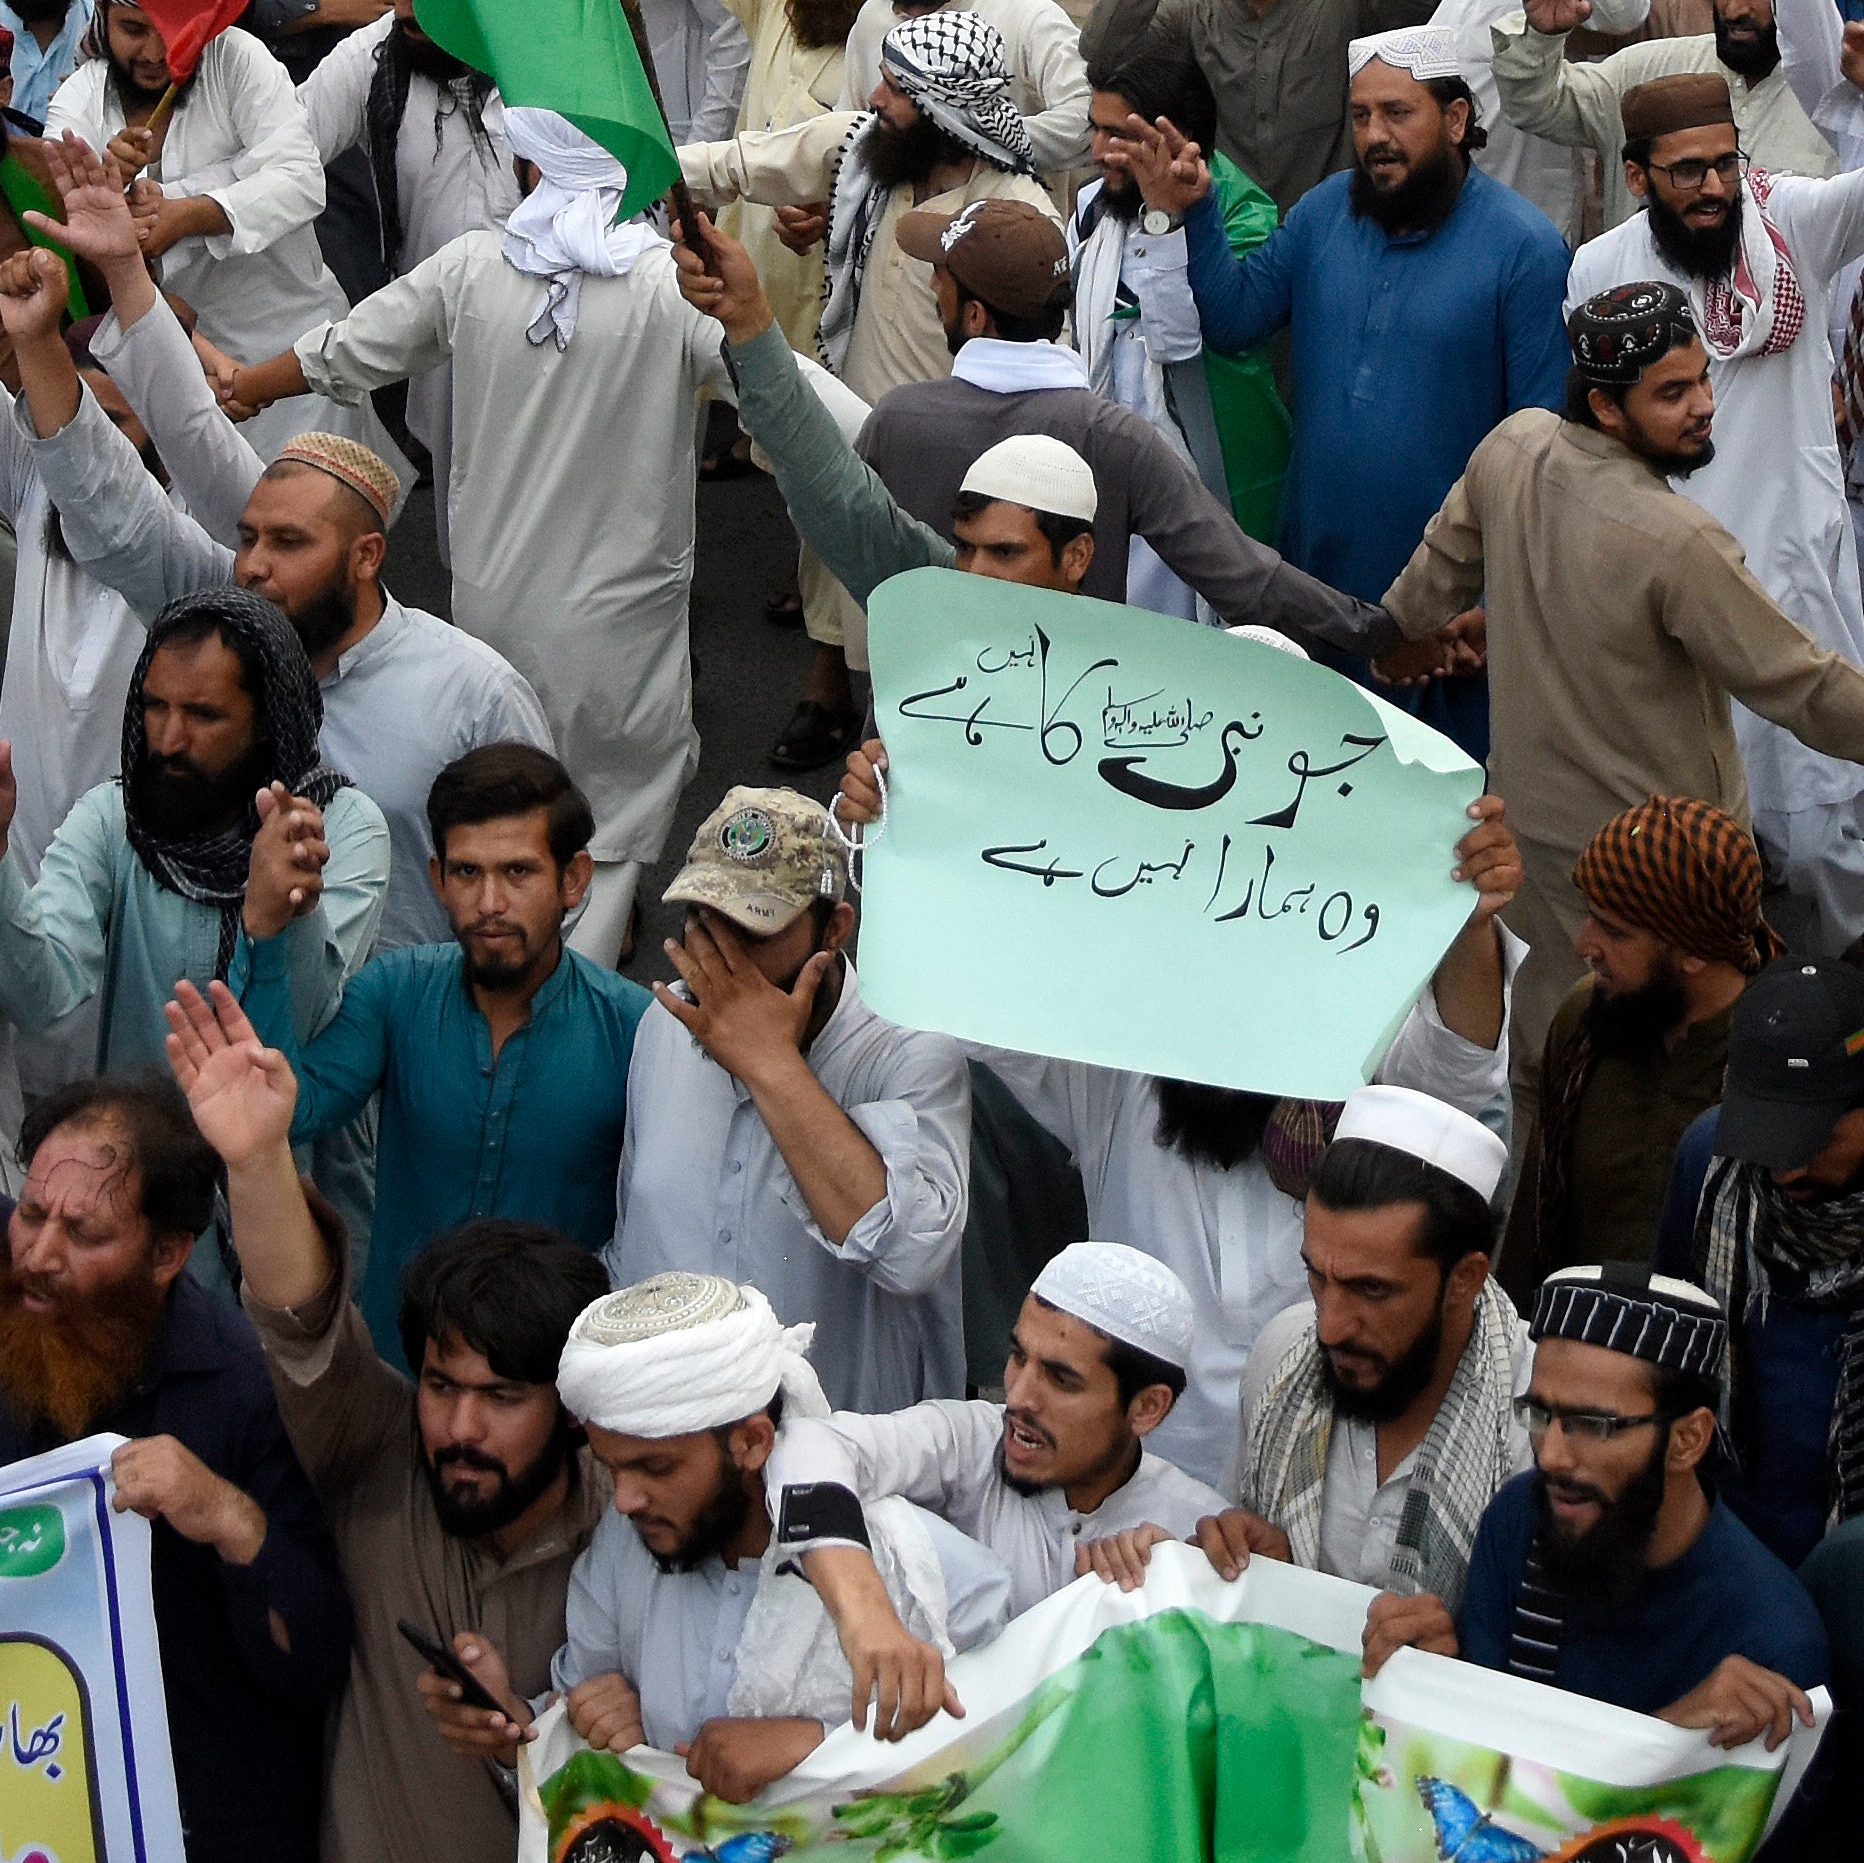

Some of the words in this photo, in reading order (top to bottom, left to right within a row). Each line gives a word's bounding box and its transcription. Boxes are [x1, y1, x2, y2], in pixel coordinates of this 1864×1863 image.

[898, 675, 1034, 747] ہے
[1033, 623, 1119, 765] کا
[1097, 711, 1263, 811] نبی
[1245, 734, 1389, 829] جو
[980, 837, 1084, 887] ہے
[1091, 837, 1196, 898] نہیں
[1204, 834, 1316, 923] ہمارا
[1318, 890, 1381, 954] وہ
